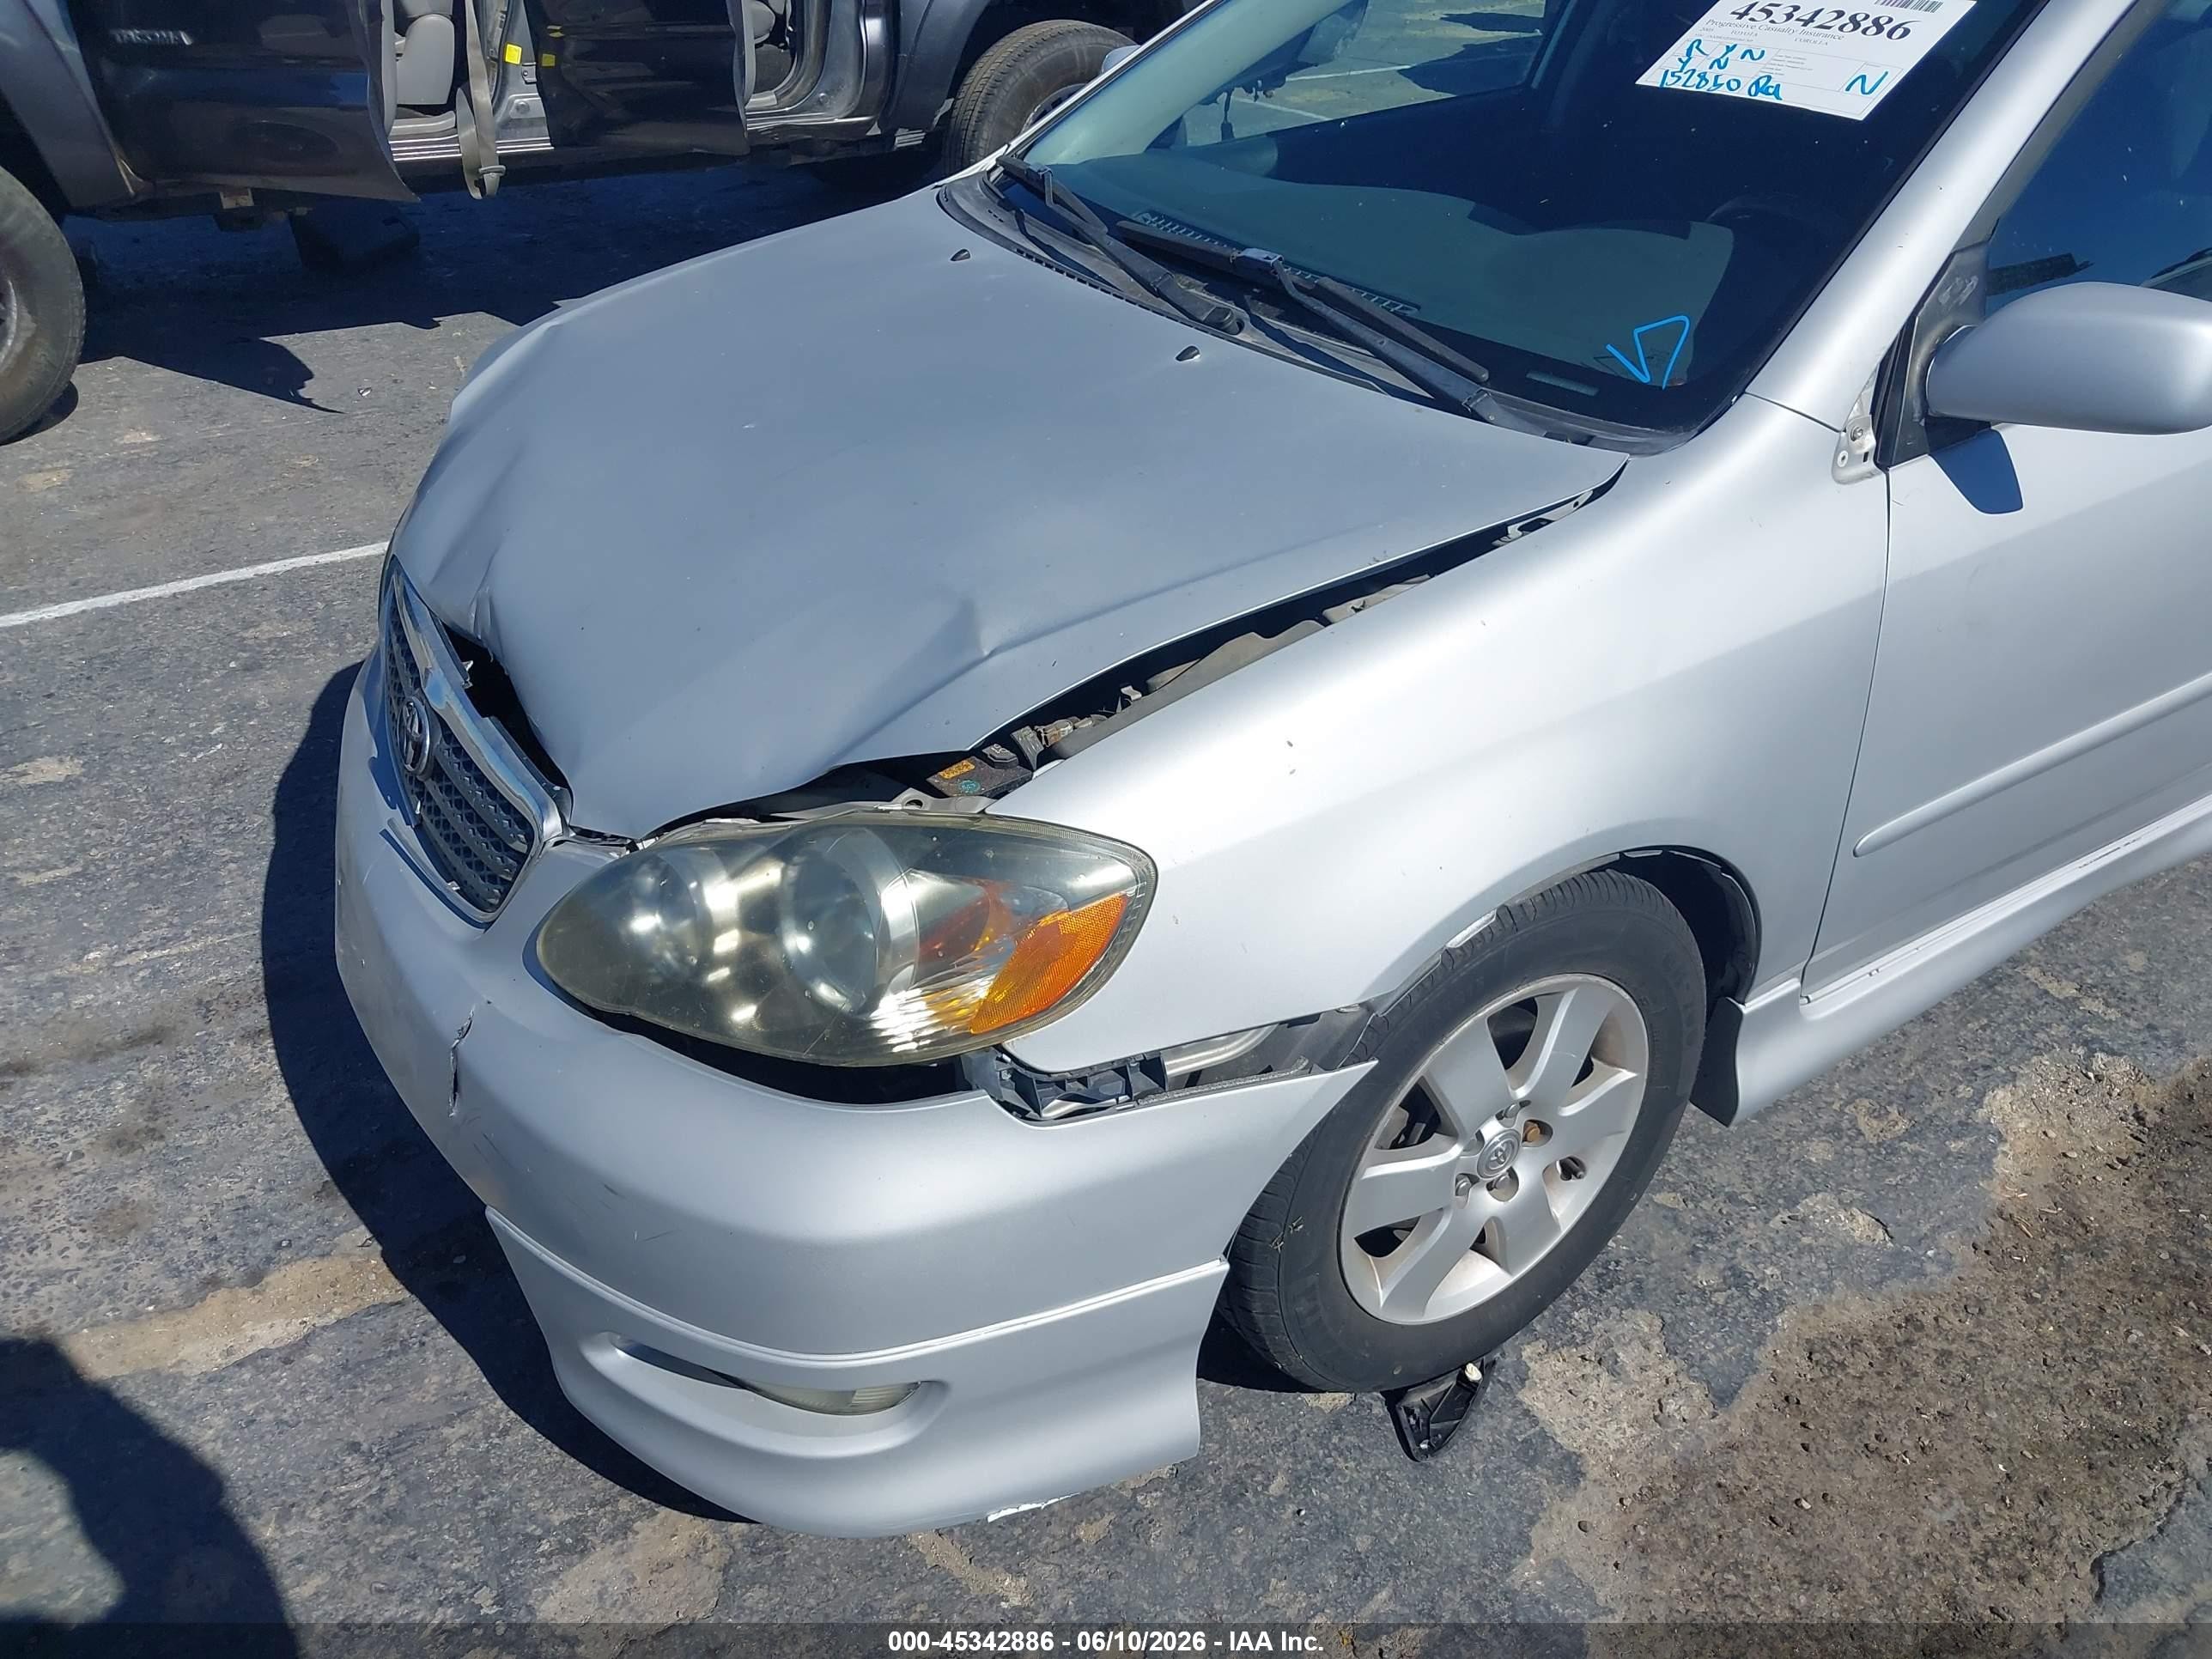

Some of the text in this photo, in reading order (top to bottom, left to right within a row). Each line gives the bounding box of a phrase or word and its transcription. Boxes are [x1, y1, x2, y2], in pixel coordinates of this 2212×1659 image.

[1706, 19, 1845, 40] Progressive Casualty Insurance
[1730, 2, 1923, 40] 45342886
